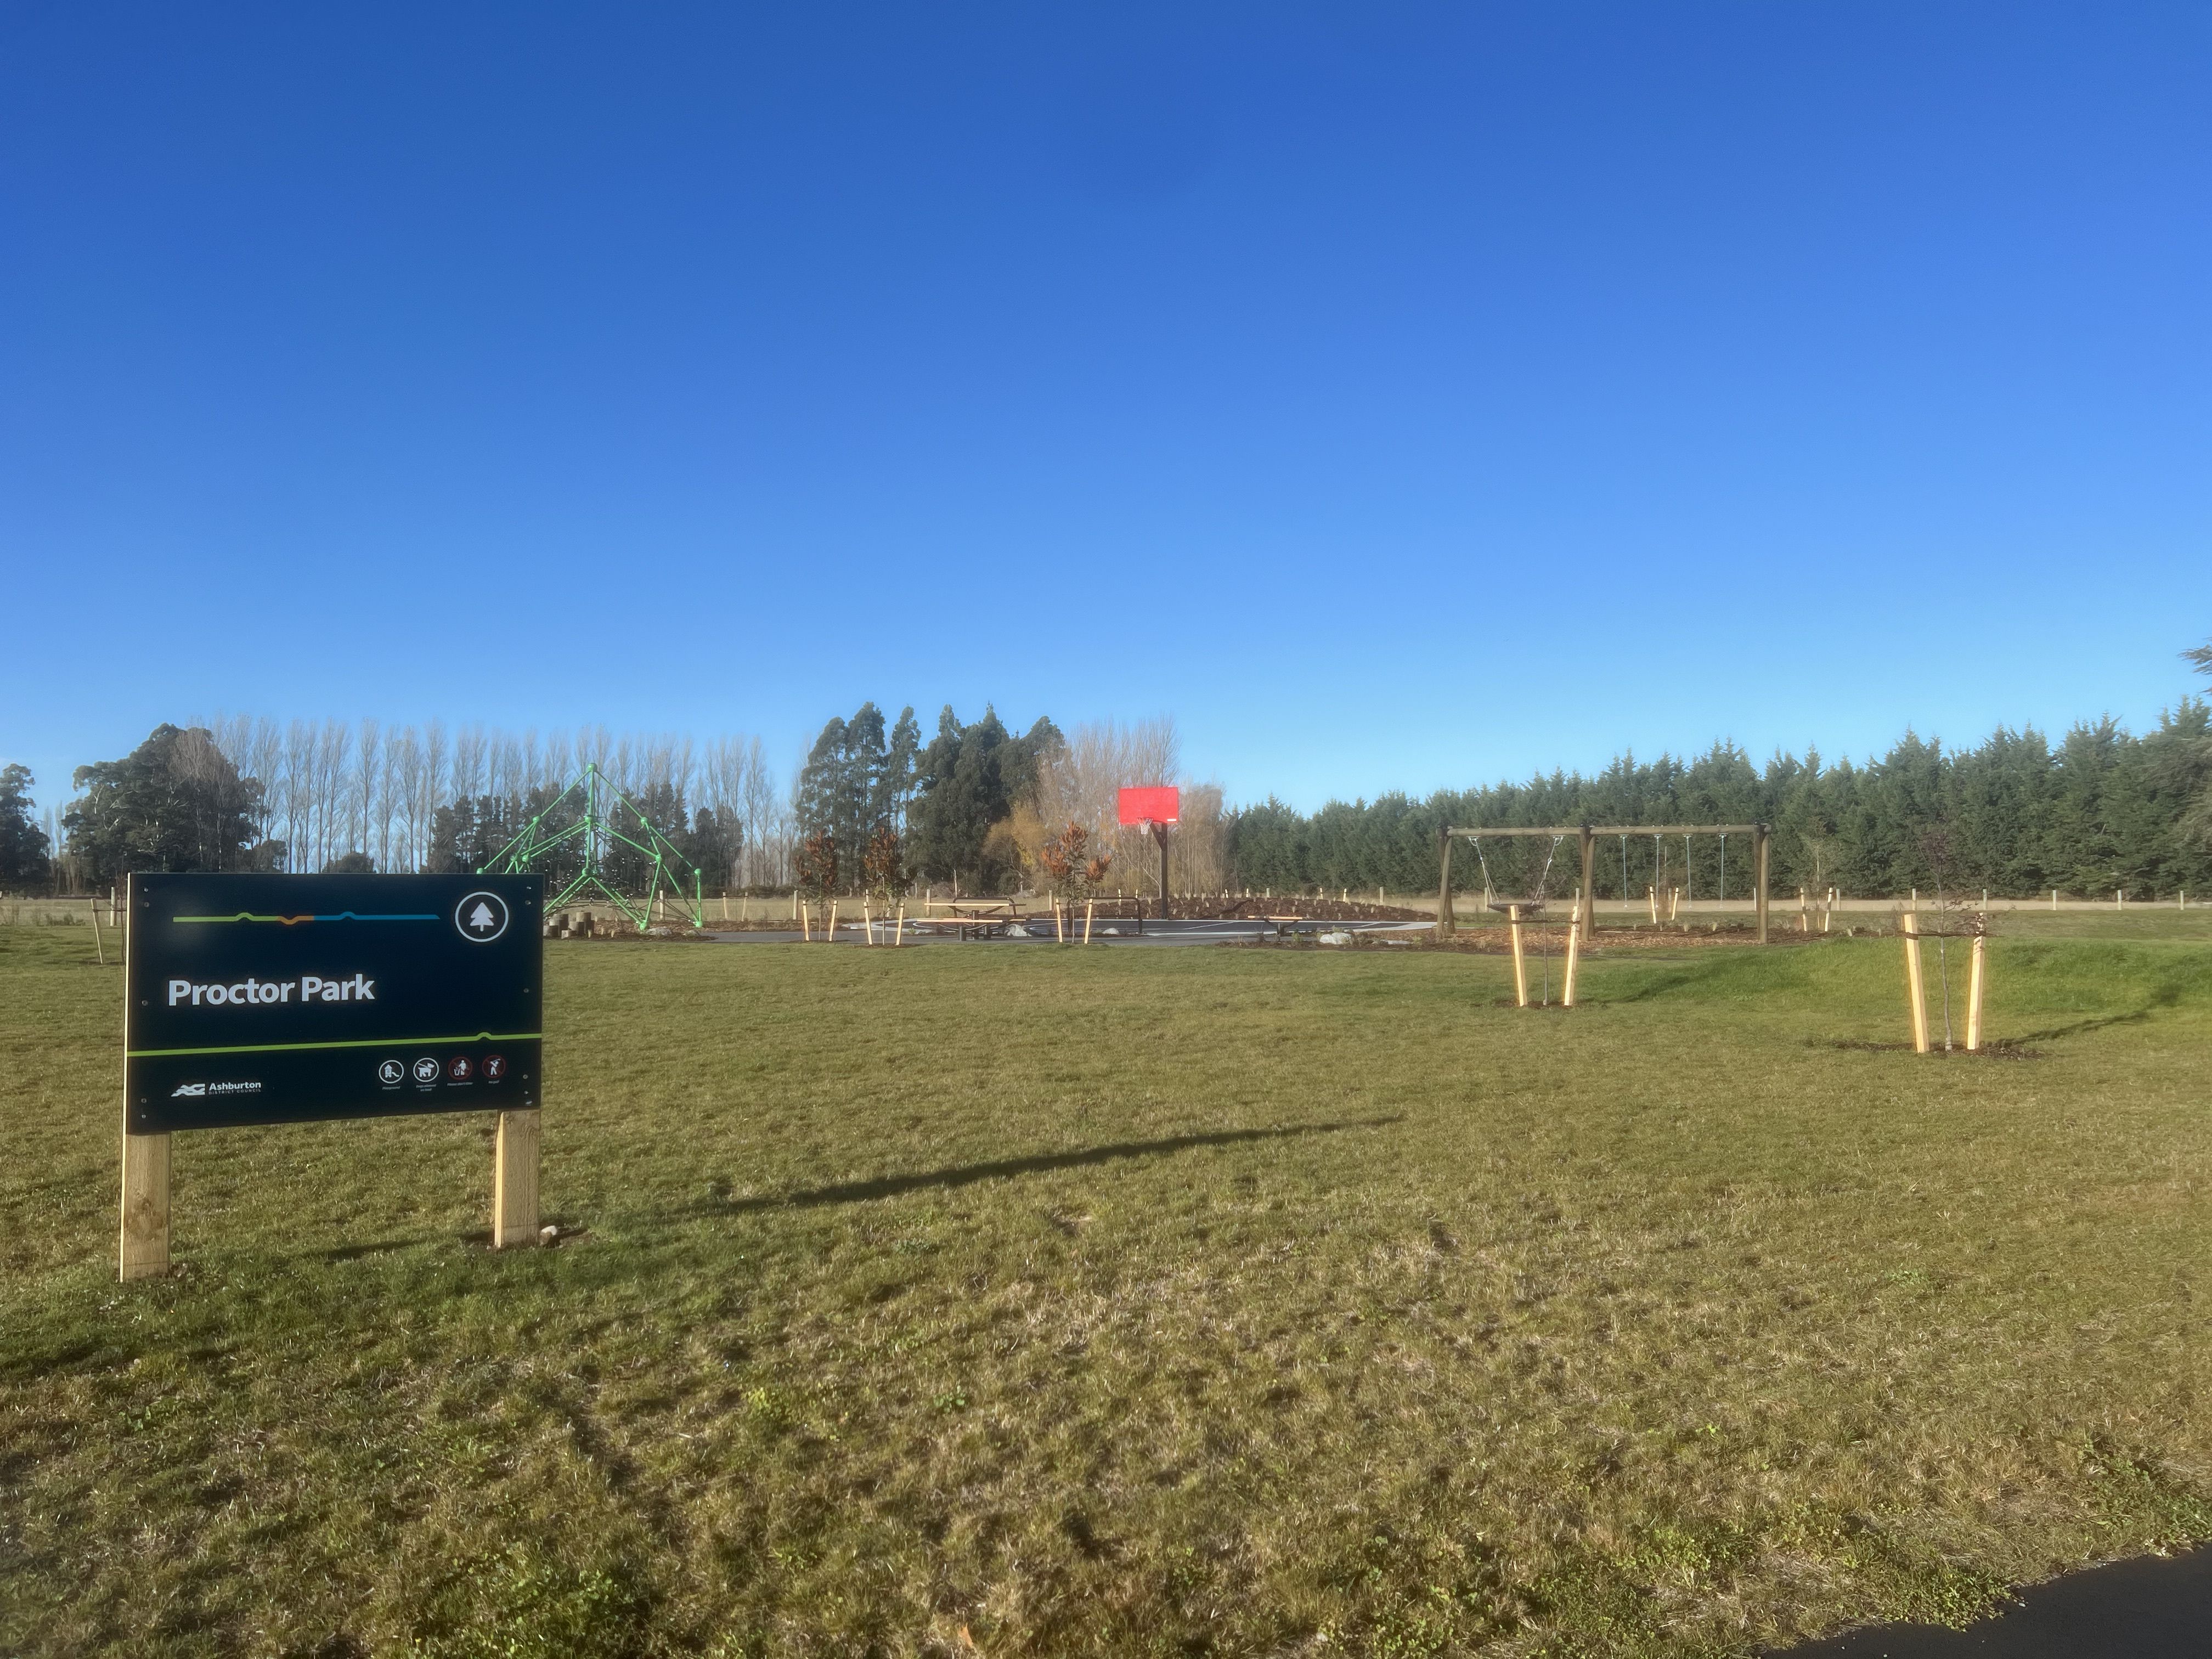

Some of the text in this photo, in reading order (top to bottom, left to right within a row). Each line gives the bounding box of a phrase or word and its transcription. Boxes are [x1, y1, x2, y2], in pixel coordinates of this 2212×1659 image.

[168, 973, 375, 1006] Proctor Park
[209, 1082, 261, 1091] Ashburton
